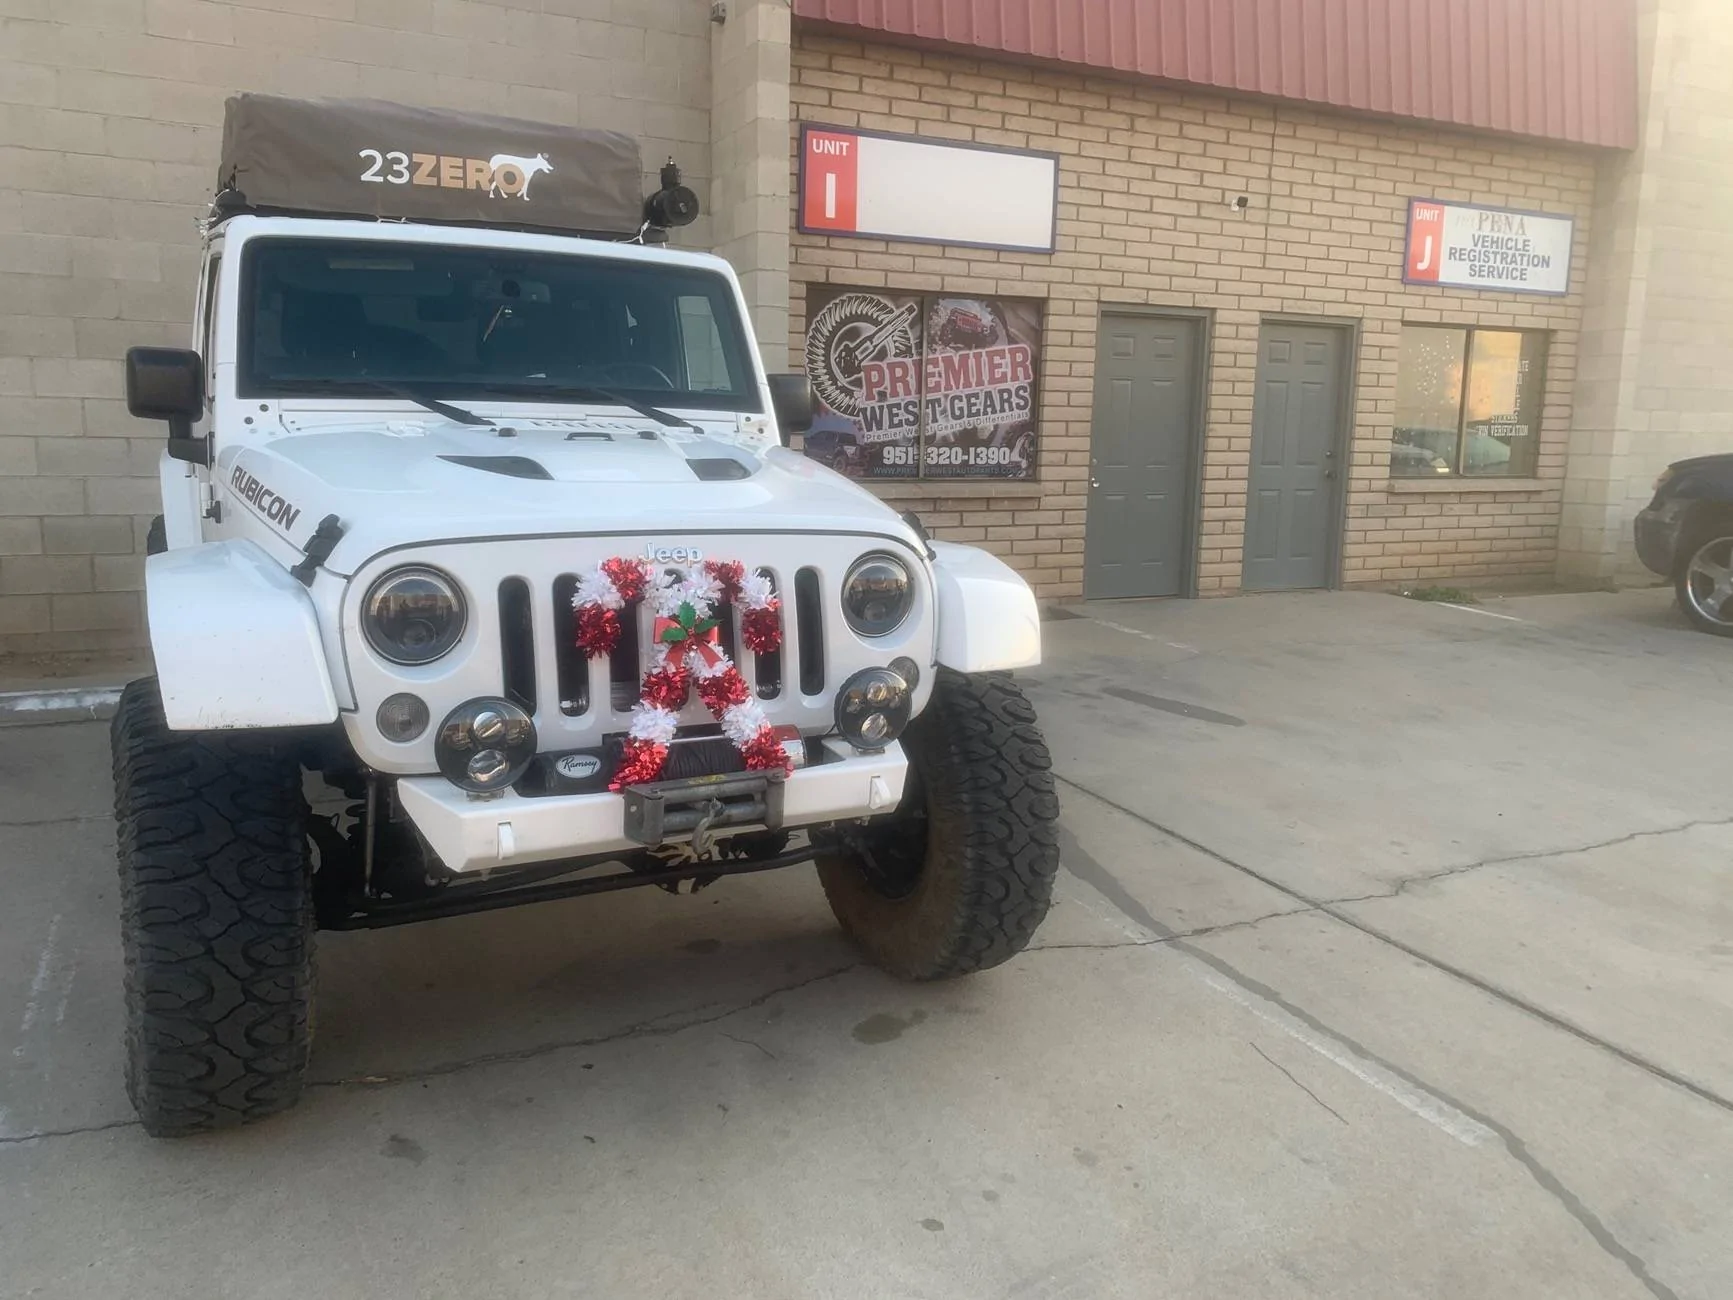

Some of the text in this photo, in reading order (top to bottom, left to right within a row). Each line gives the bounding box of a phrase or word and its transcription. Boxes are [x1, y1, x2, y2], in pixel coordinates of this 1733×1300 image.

[812, 138, 850, 156] UNIT
[358, 149, 525, 194] 23ZERO
[1415, 207, 1440, 222] UNIT
[1416, 235, 1433, 271] J
[1471, 233, 1532, 253] VEHICLE
[1448, 246, 1551, 269] REGISTRATION
[1468, 263, 1528, 281] SERVICE
[861, 346, 1032, 401] PREMIER
[860, 384, 1030, 433] WEST GEARS
[866, 431, 901, 442] Premier
[937, 422, 964, 432] Gears
[975, 411, 1029, 426] Differentials
[1491, 425, 1529, 437] VERIFICATION
[231, 465, 301, 532] RUBICON
[638, 543, 703, 568] Jeep
[561, 755, 598, 774] Ramsey
